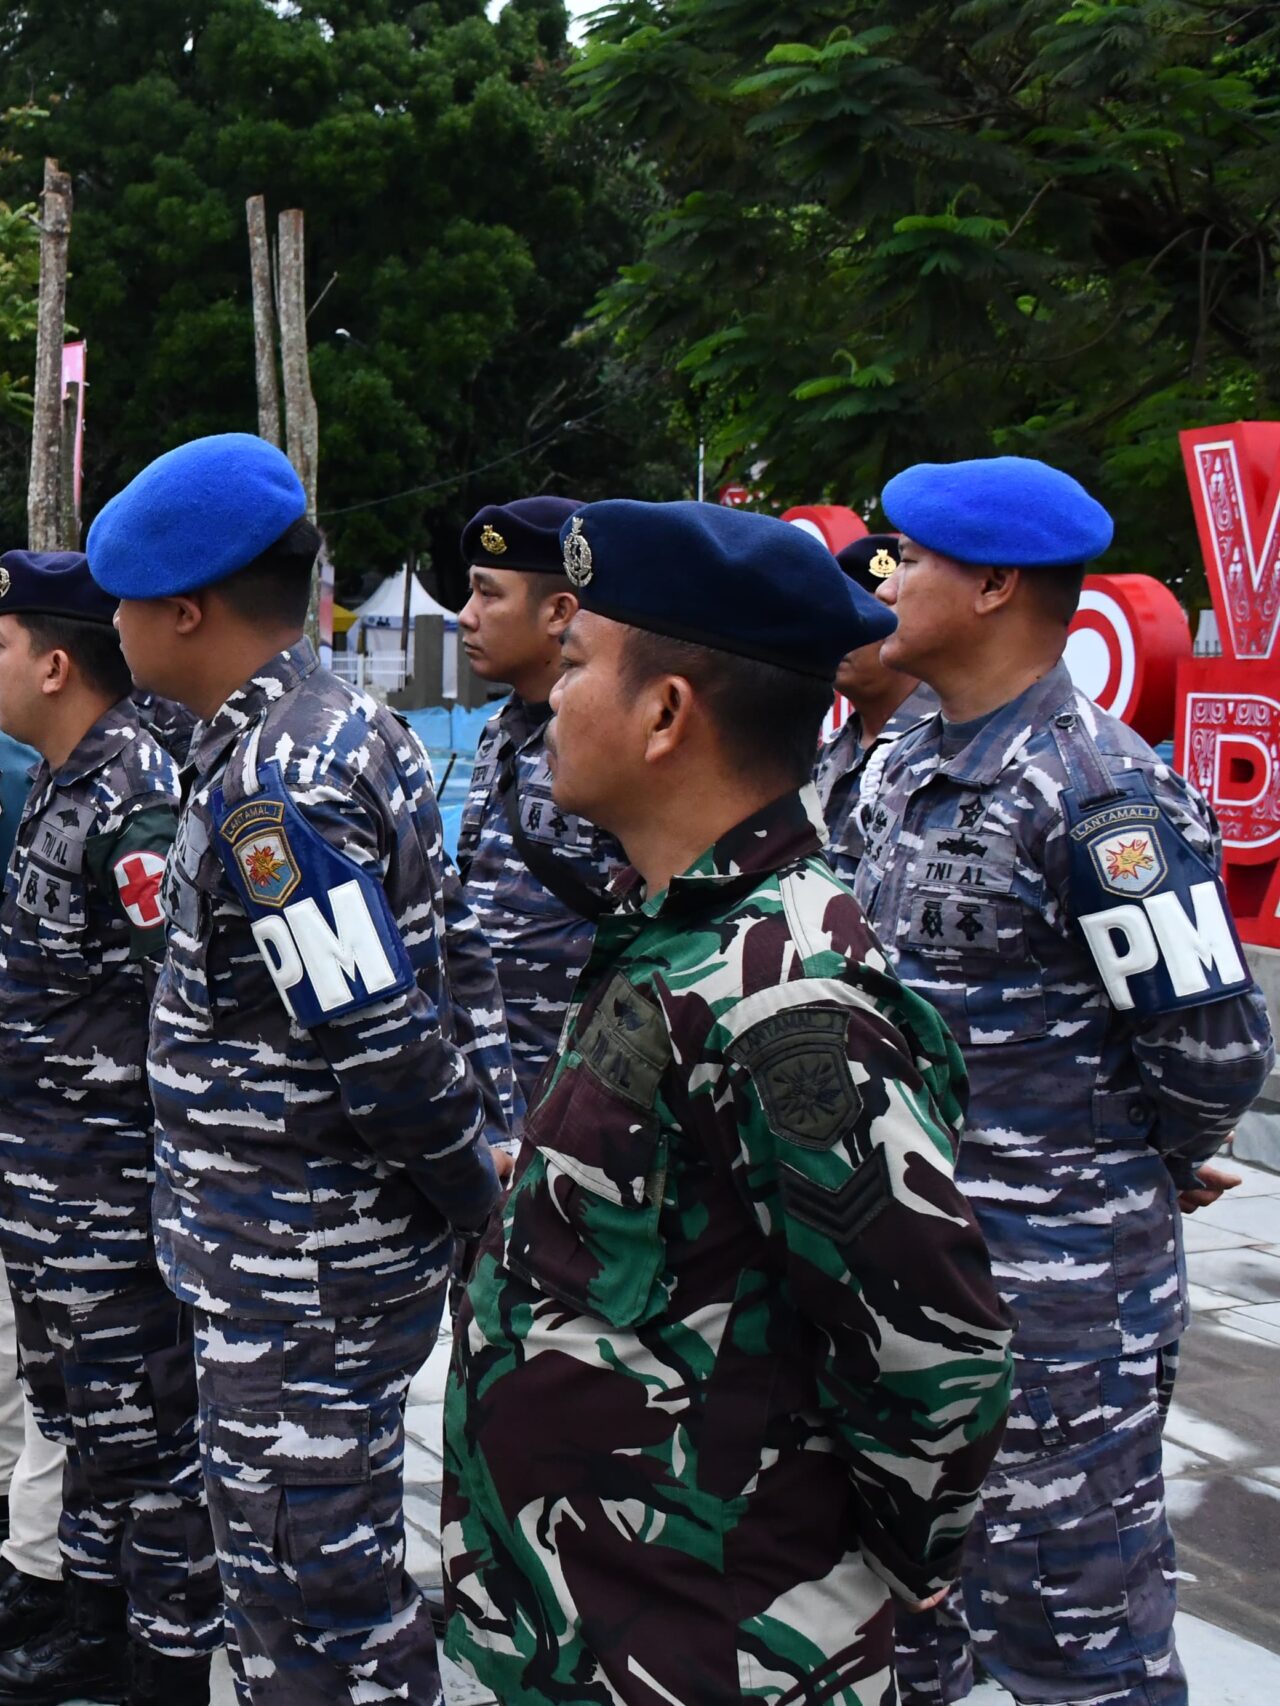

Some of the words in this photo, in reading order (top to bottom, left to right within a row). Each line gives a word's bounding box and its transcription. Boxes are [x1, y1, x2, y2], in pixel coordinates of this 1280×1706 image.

[226, 804, 269, 835] LANTAMAL
[1076, 807, 1146, 836] LANTAMAL
[41, 831, 57, 858] TNI
[53, 840, 68, 867] AL
[925, 862, 953, 881] TNI
[958, 865, 986, 887] AL
[250, 879, 398, 1021] PM
[1077, 881, 1247, 1011] PM
[735, 1012, 813, 1056] LANTAMAL
